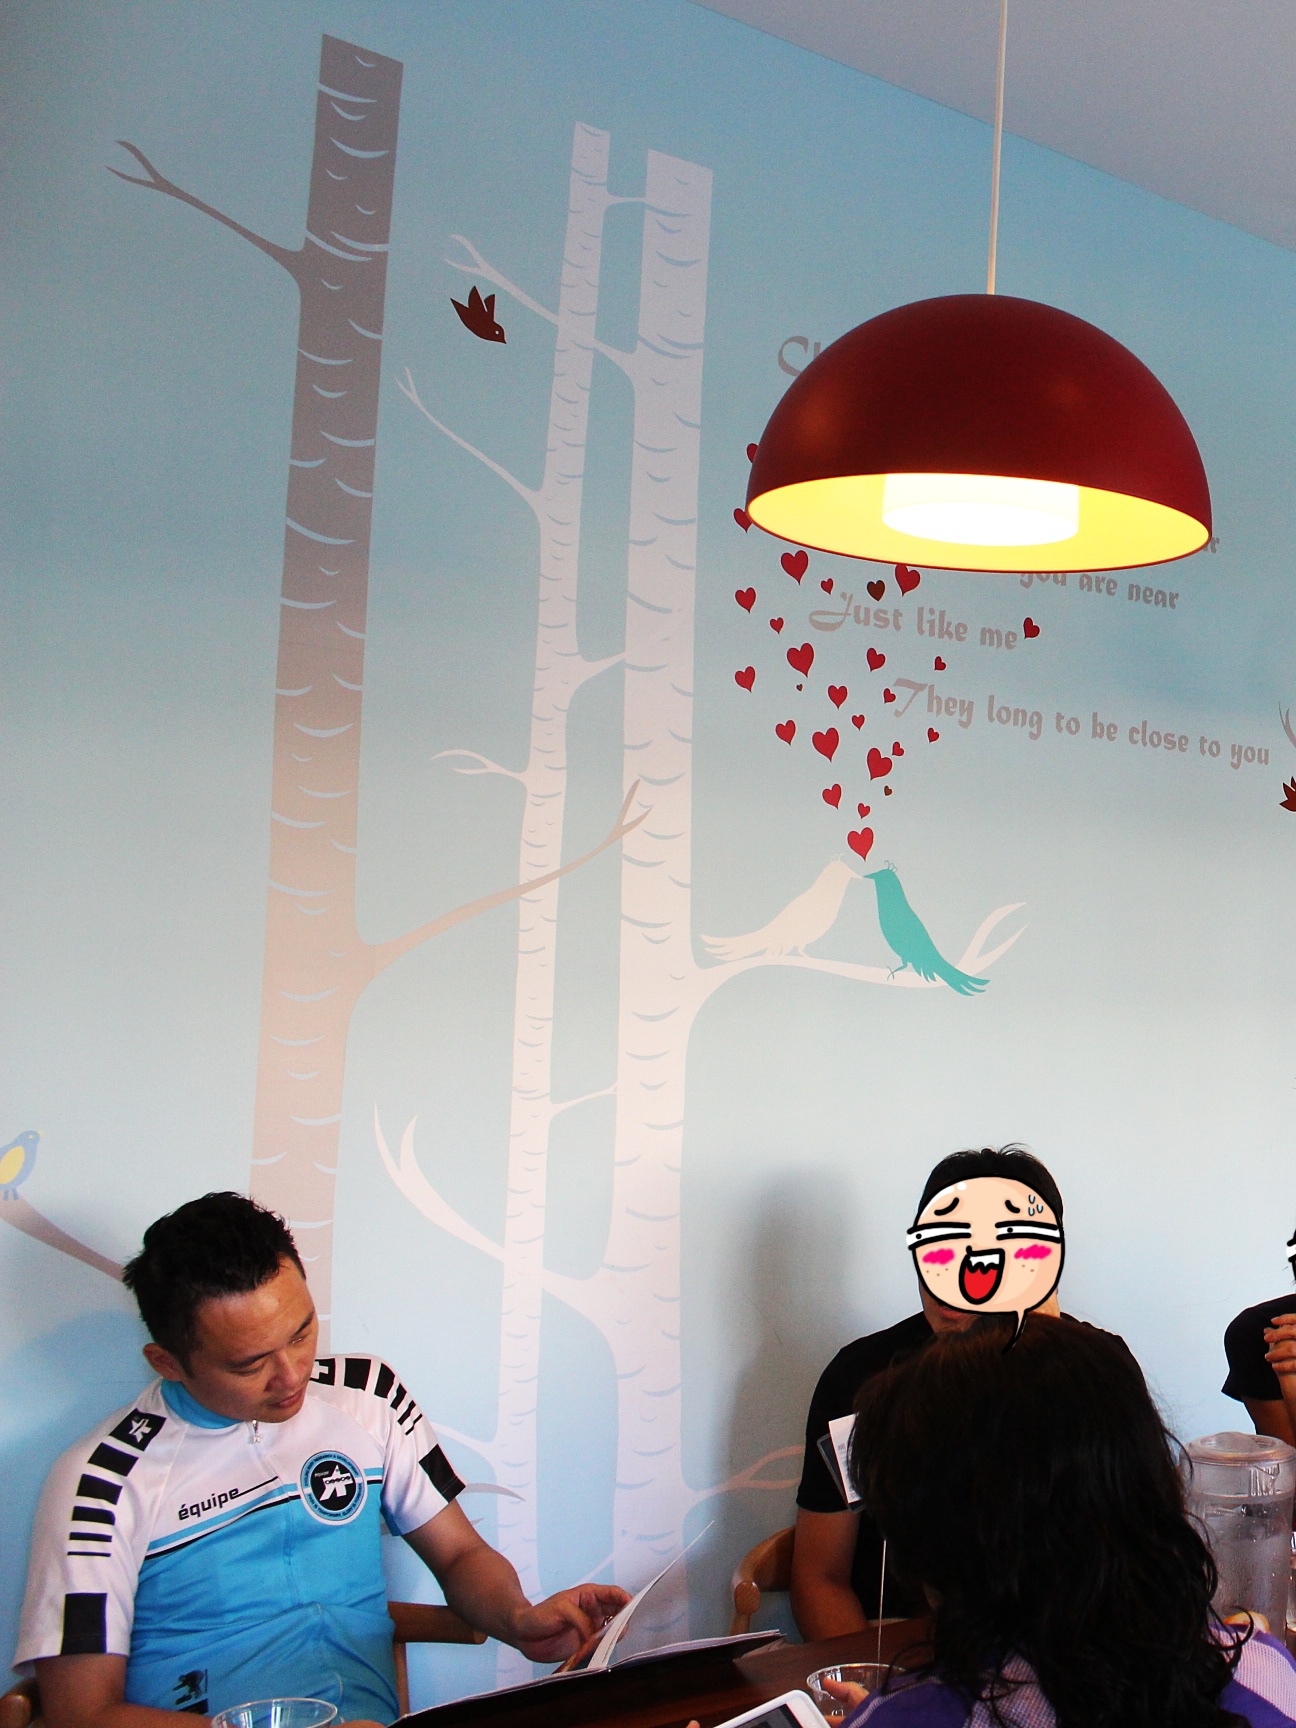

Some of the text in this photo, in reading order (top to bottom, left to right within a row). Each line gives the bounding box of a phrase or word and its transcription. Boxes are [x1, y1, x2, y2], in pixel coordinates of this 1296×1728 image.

[1078, 573, 1118, 596] are
[1127, 582, 1179, 609] near
[808, 591, 1018, 650] Just like me
[893, 677, 1270, 770] They long to be close to you
[178, 1487, 239, 1521] équipe
